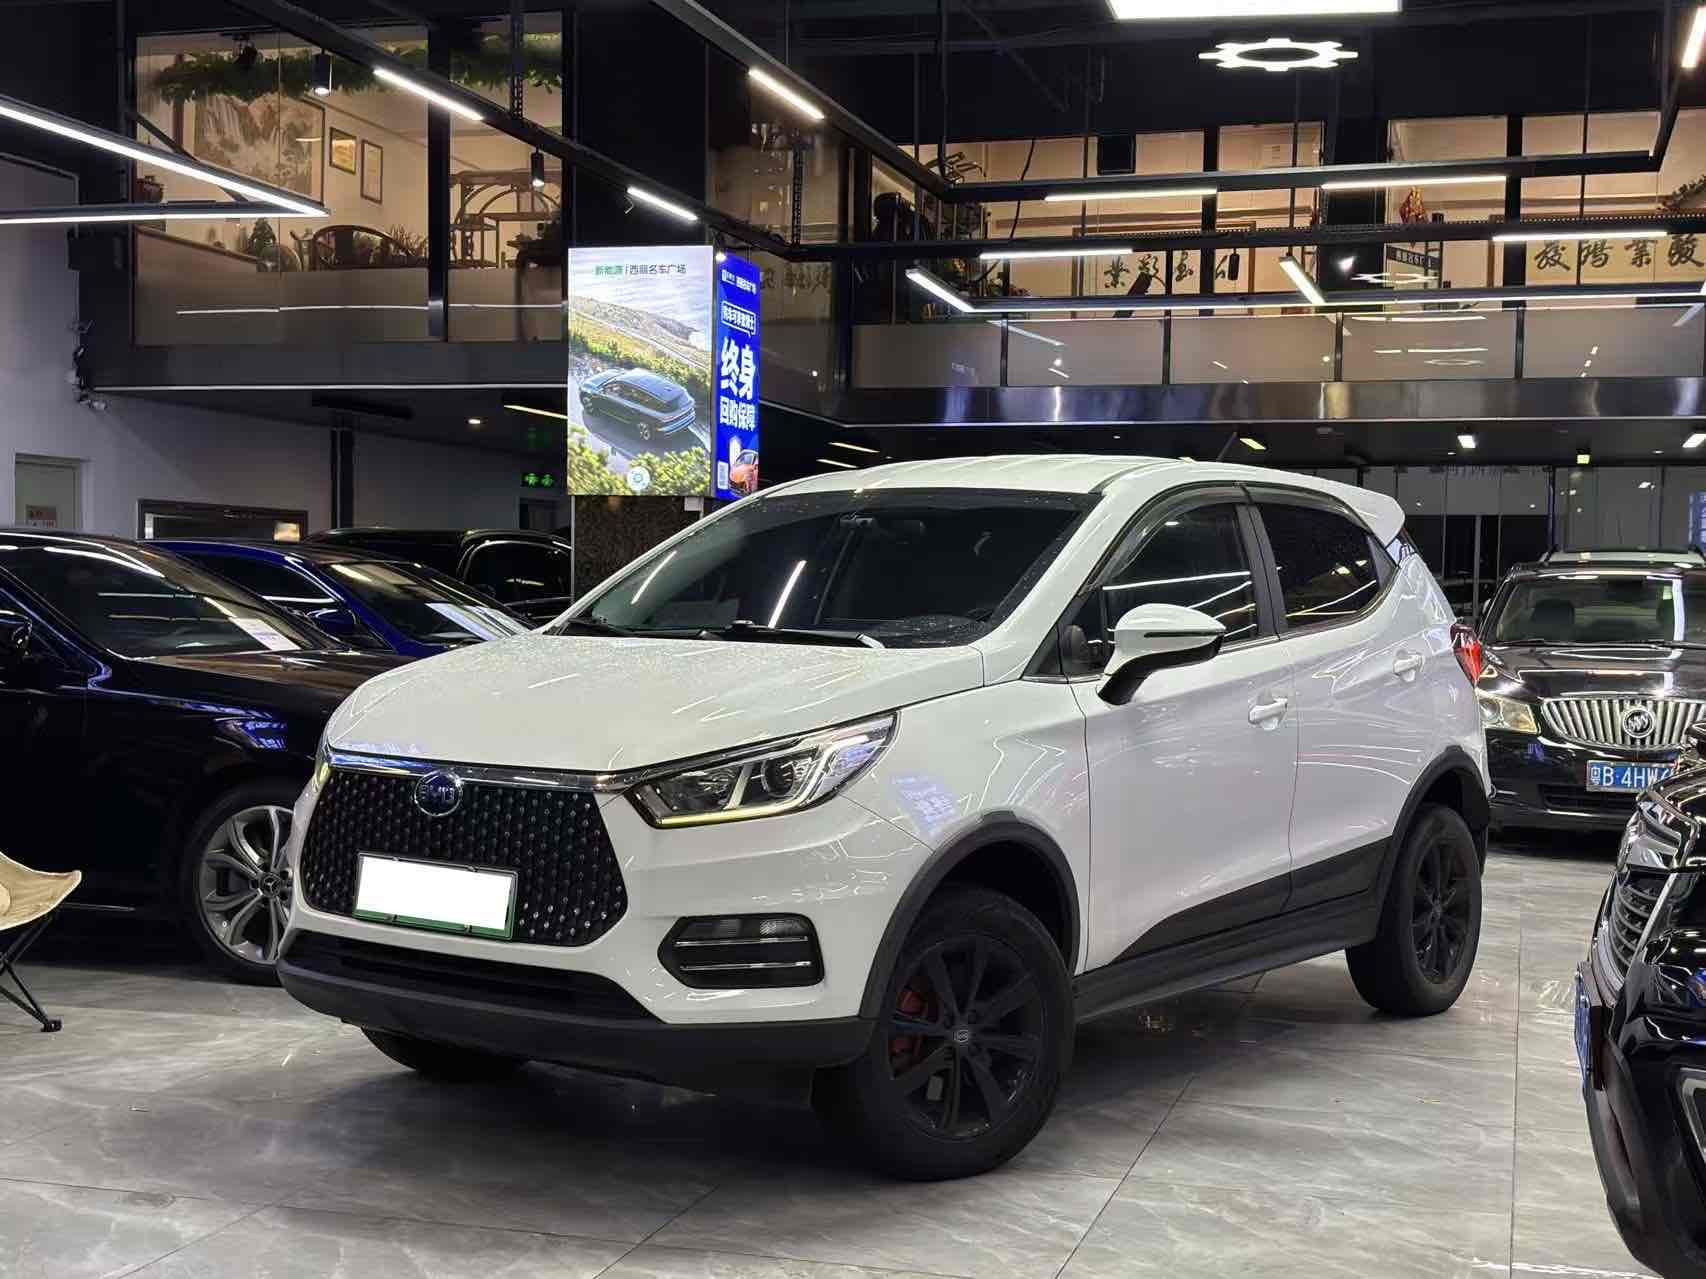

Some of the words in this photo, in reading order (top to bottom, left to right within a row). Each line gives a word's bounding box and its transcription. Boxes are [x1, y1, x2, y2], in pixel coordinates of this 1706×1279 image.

[720, 336, 756, 400] 终身
[720, 396, 756, 432] 回购保障
